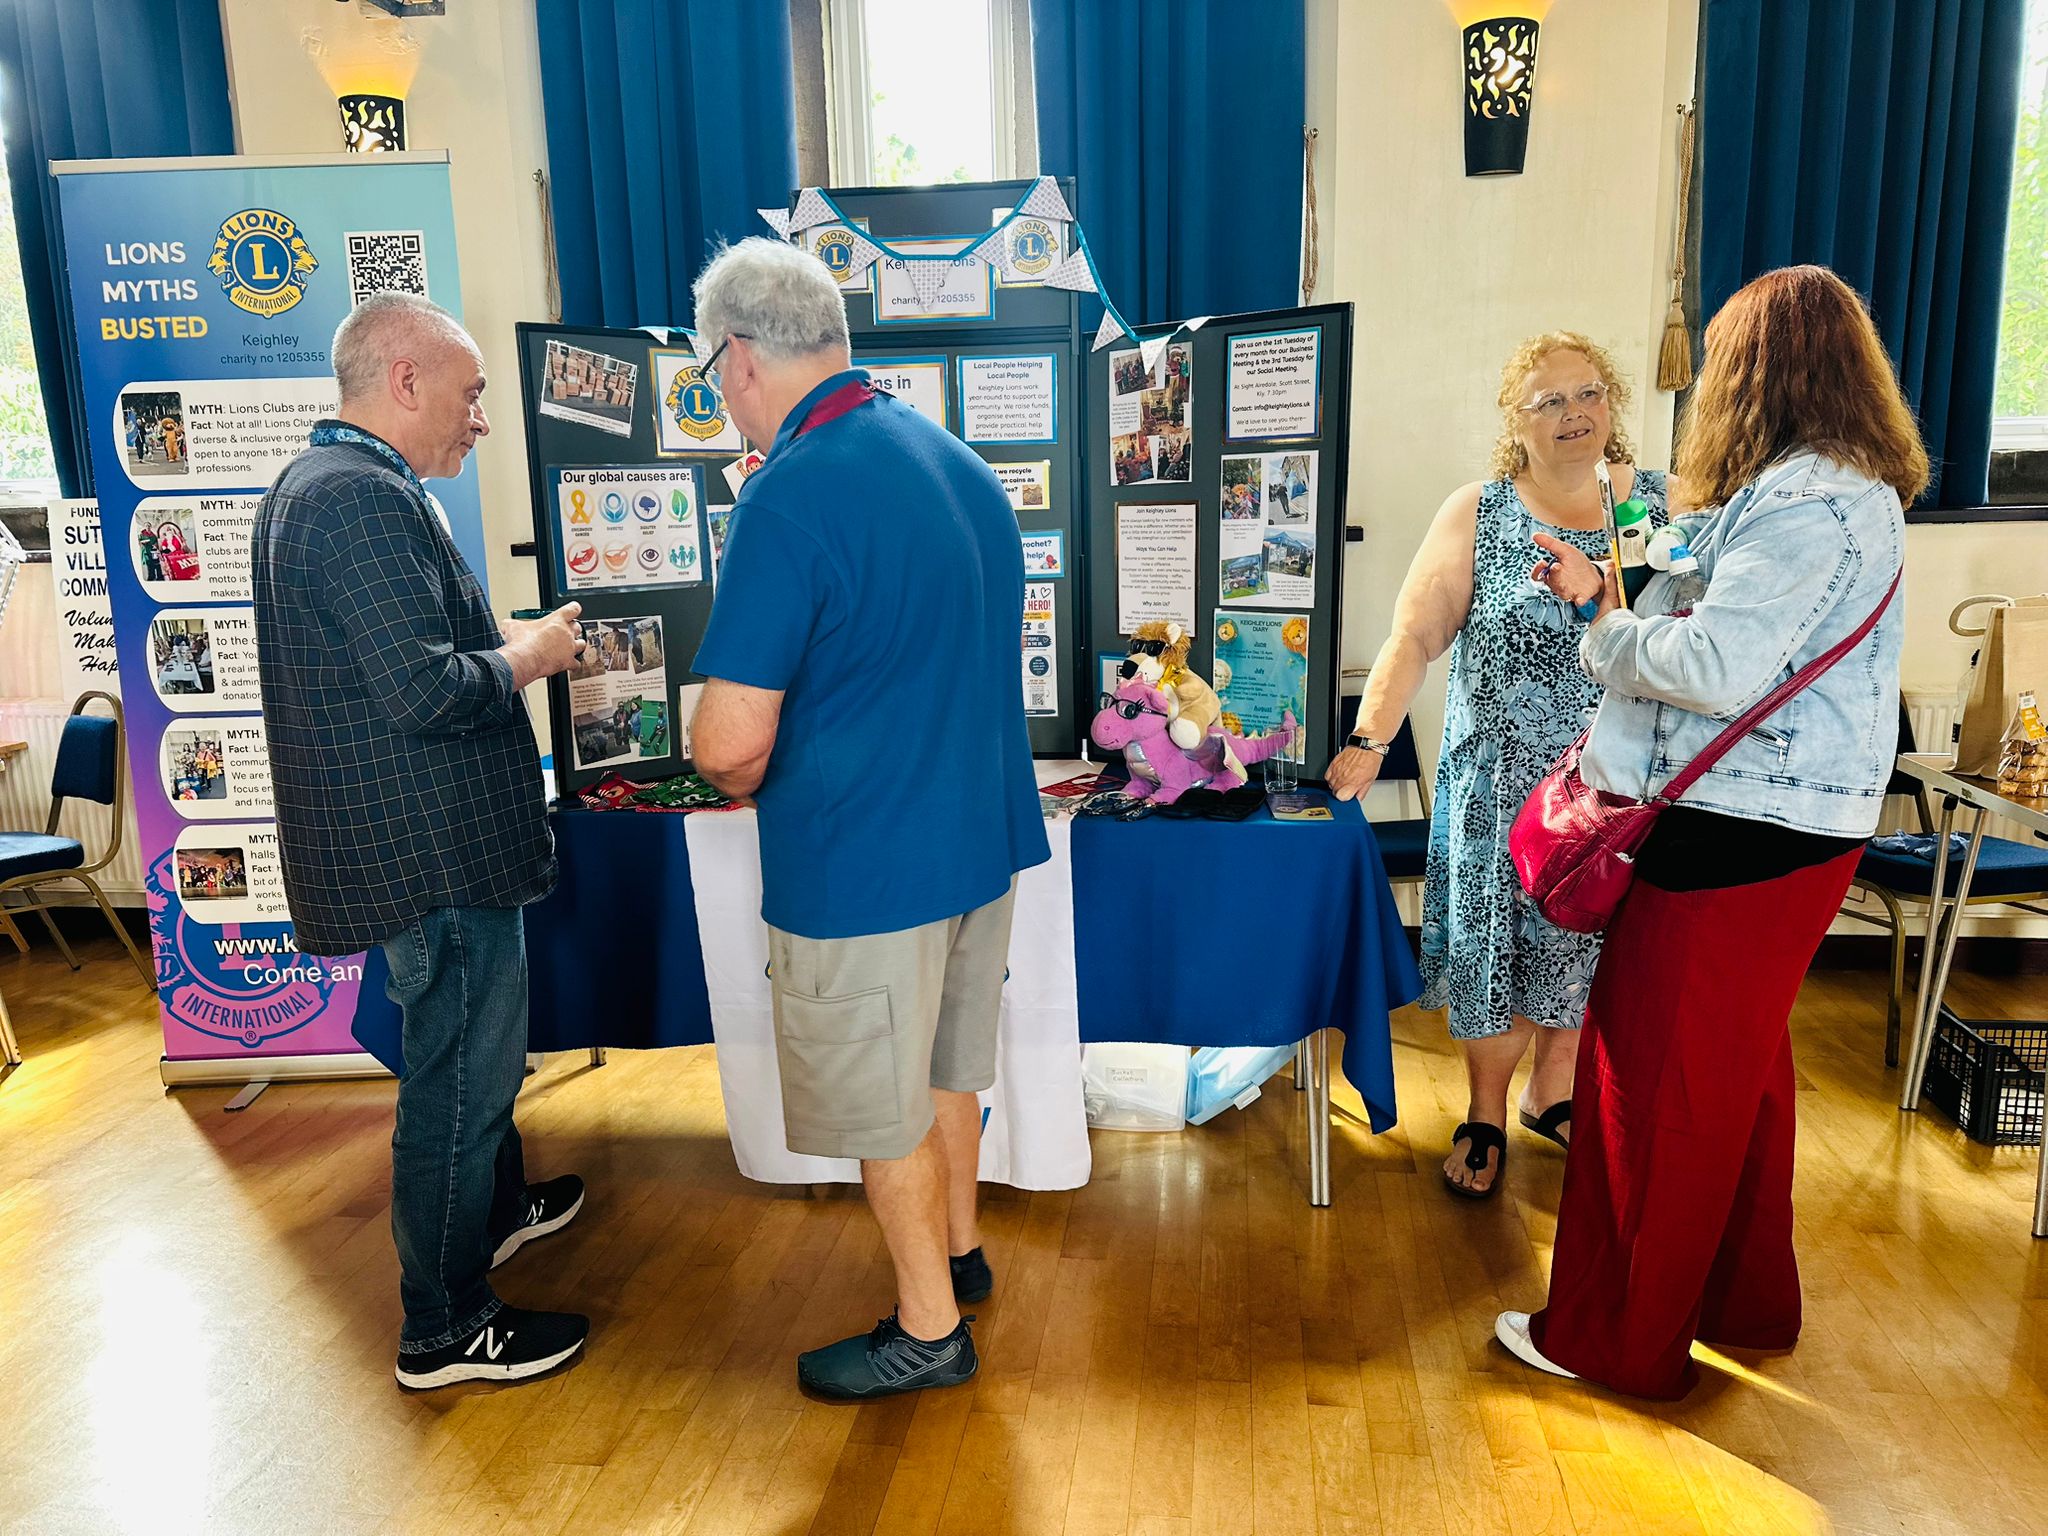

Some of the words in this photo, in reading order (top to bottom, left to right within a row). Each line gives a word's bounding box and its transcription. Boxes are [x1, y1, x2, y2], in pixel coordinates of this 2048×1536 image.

[226, 213, 291, 237] LIONS
[822, 233, 851, 243] LIONS
[105, 242, 186, 265] LIONS
[831, 247, 844, 265] L
[249, 243, 280, 280] L
[102, 279, 198, 302] MYTHS
[234, 290, 297, 310] INTERNATIONAL
[937, 294, 975, 303] 1205355
[100, 316, 208, 340] BUSTED
[242, 334, 299, 348] Keighley
[220, 353, 256, 365] charity
[260, 354, 273, 363] no
[277, 352, 325, 362] 1205355
[898, 375, 911, 389] in
[692, 390, 710, 414] L
[189, 404, 226, 414] MYTH:
[229, 403, 259, 414] Lions
[263, 402, 294, 413] Clubs
[298, 403, 315, 412] are
[216, 420, 234, 429] Not
[236, 420, 246, 428] at
[249, 419, 262, 428] all!
[265, 419, 290, 428] Lions
[193, 436, 227, 444] diverse
[230, 435, 237, 443] &
[241, 434, 282, 443] inclusive
[194, 451, 218, 459] open
[222, 450, 231, 458] to
[234, 450, 268, 459] anyone
[272, 448, 288, 456] 18+
[564, 472, 585, 483] Our
[589, 471, 624, 485] global
[627, 472, 666, 482] causes
[669, 472, 690, 481] are:
[200, 500, 236, 510] MYTH:
[202, 517, 253, 527] commitm
[65, 526, 100, 544] SUT
[230, 533, 248, 541] The
[206, 548, 231, 556] clubs
[234, 547, 249, 555] are
[207, 561, 250, 570] contribut
[209, 575, 236, 584] motto
[211, 589, 241, 598] makes
[1028, 600, 1051, 611] HERO!
[214, 620, 250, 629] MYTH:
[74, 632, 116, 650] Mak
[217, 637, 227, 645] to
[231, 636, 248, 645] the
[228, 665, 245, 673] real
[221, 678, 228, 687] &
[232, 772, 246, 780] We
[233, 785, 259, 793] focus
[235, 798, 252, 807] and
[255, 798, 273, 806] fina
[250, 850, 276, 859] halls
[254, 878, 265, 886] bit
[255, 891, 283, 899] works
[257, 904, 264, 912] &
[214, 933, 298, 956] www.k
[244, 963, 322, 985] Come
[330, 964, 363, 982] an
[181, 991, 313, 1029] INTERNATIONAL
